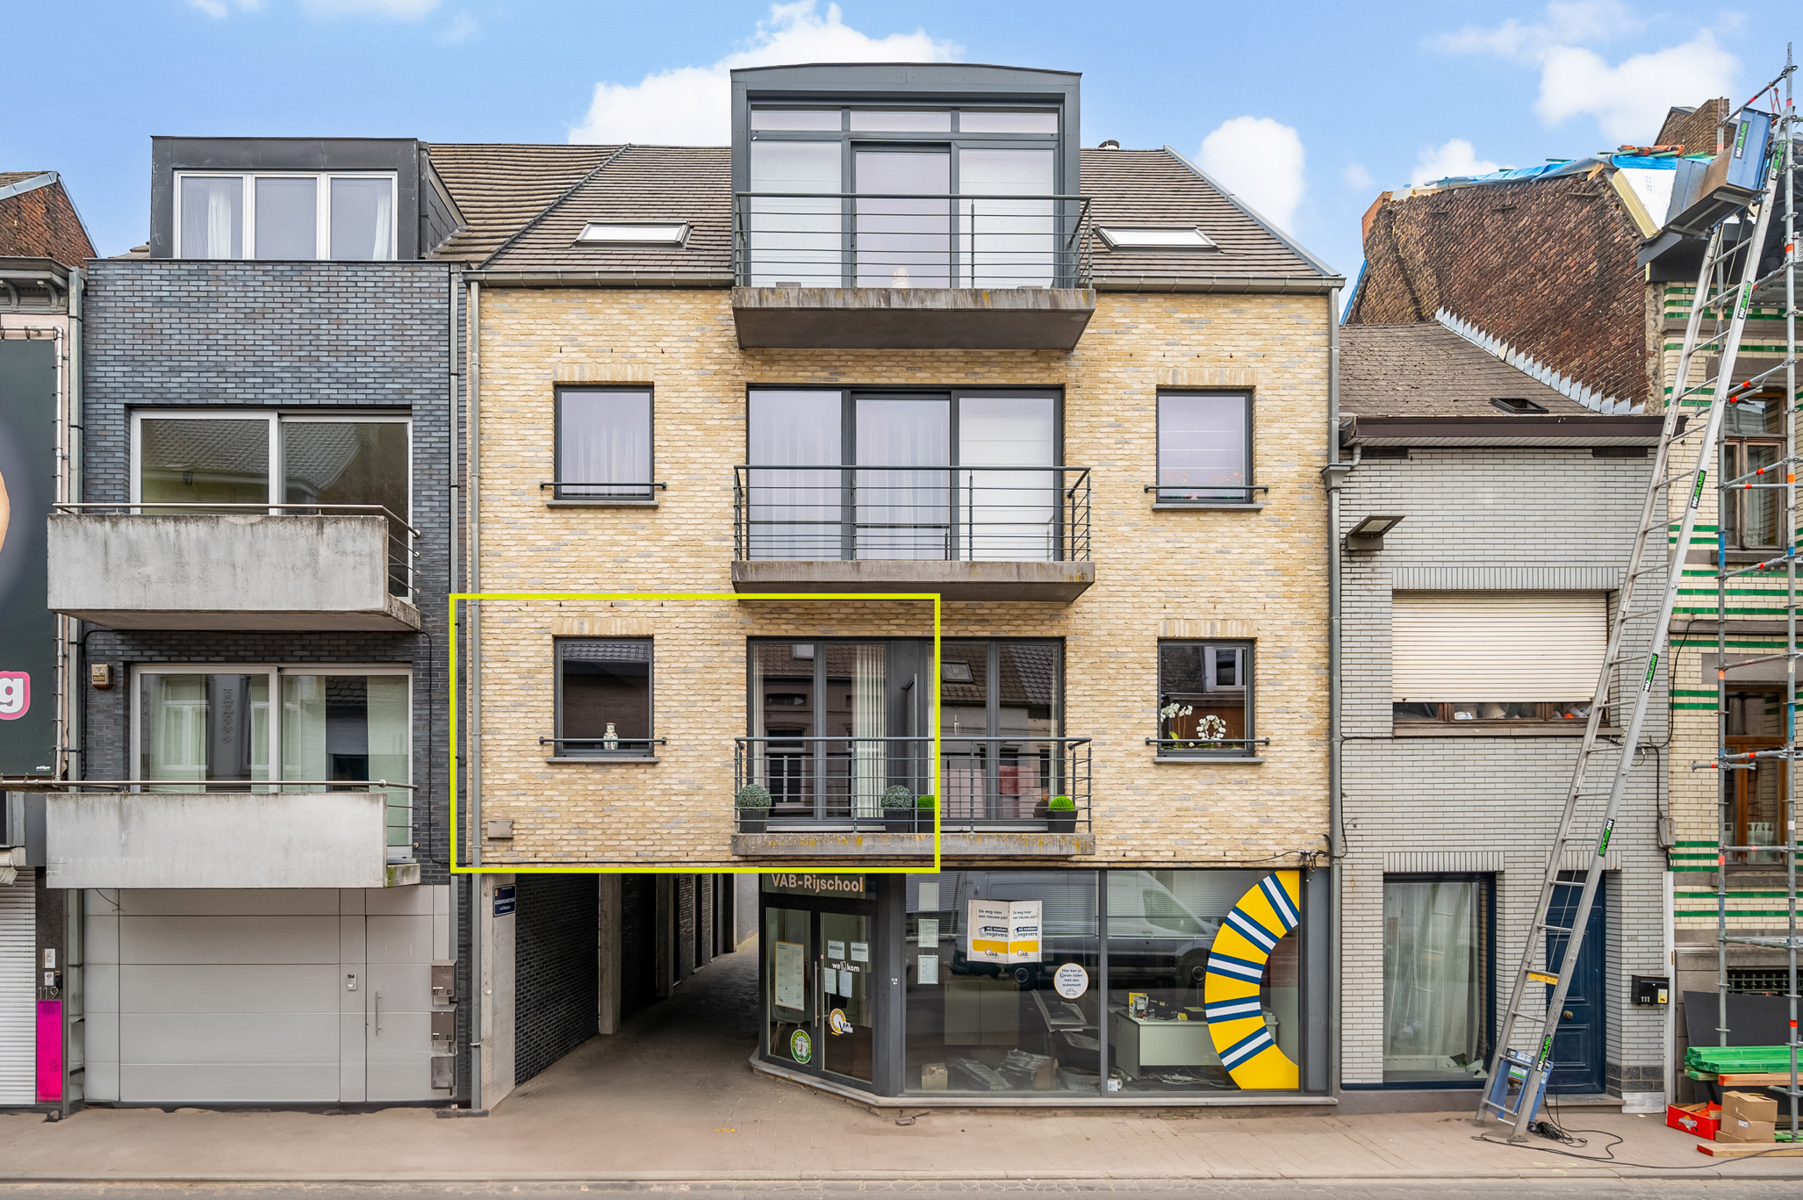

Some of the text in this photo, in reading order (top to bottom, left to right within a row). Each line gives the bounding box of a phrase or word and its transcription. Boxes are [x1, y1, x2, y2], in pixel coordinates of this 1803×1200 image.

[1735, 122, 1747, 158] HUURLAND
[1738, 282, 1751, 318] HUURLAND
[1691, 471, 1705, 508] HUURLAND
[1644, 655, 1658, 690] HUURLAND
[1599, 820, 1614, 855] HUURLAND
[771, 873, 865, 893] VAB-Rijschool
[37, 986, 59, 1000] 119
[1536, 1036, 1551, 1071] HUURLAND
